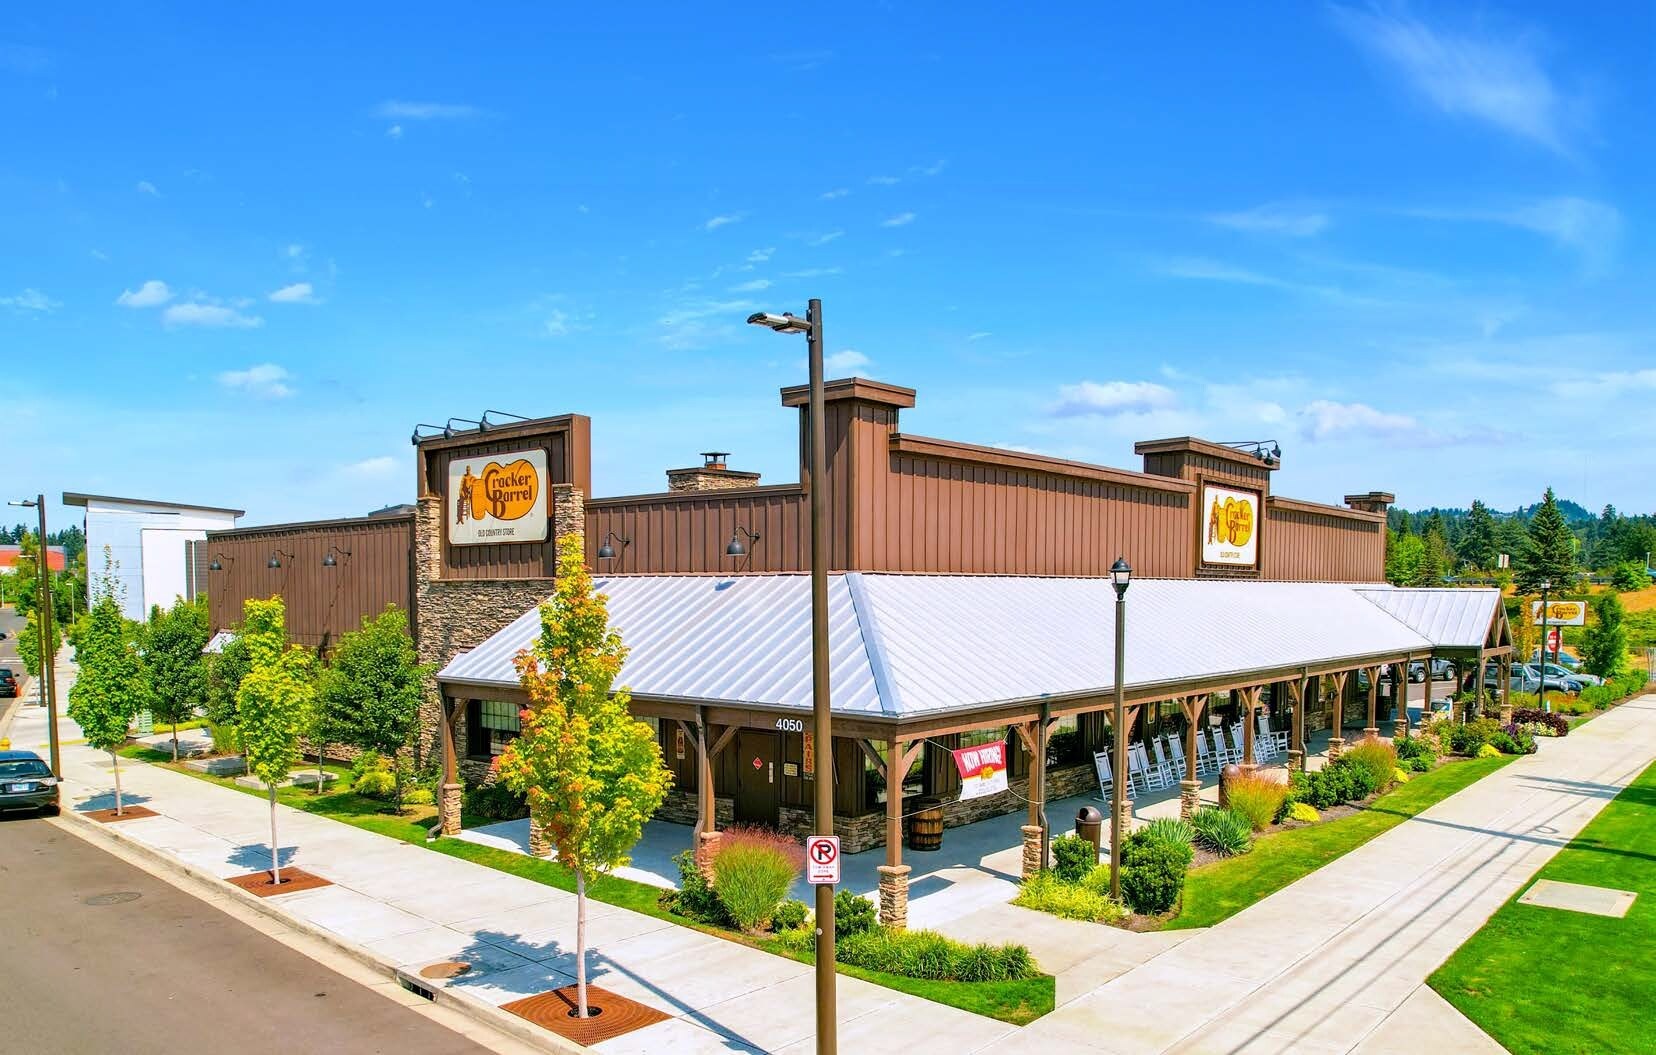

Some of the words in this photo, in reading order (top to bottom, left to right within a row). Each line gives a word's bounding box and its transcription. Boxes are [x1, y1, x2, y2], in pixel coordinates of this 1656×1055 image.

[485, 469, 531, 501] Cracker
[492, 485, 532, 518] Barrel
[1226, 503, 1250, 528] Cracker
[486, 529, 502, 537] COUNTRY
[502, 527, 515, 536] STORE
[1230, 520, 1250, 544] Barrel
[775, 718, 803, 732] 4050
[960, 751, 981, 772] NOW
